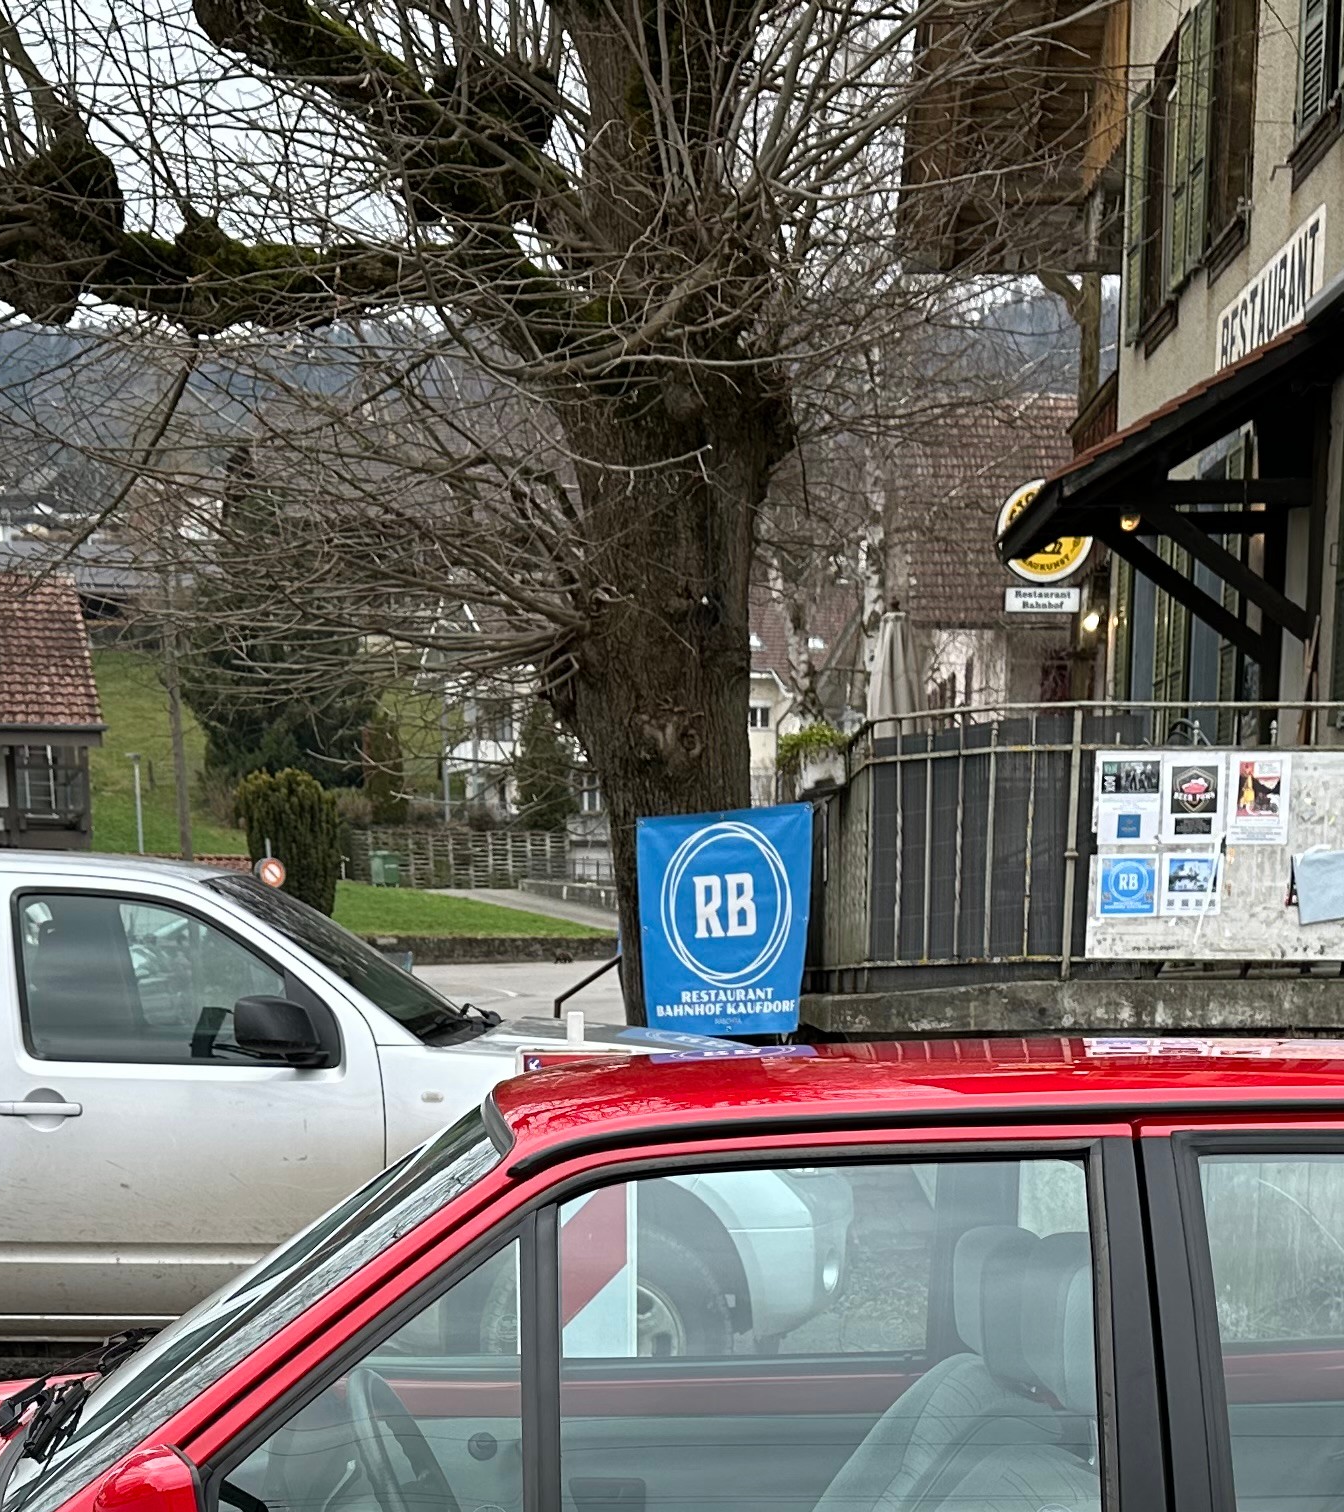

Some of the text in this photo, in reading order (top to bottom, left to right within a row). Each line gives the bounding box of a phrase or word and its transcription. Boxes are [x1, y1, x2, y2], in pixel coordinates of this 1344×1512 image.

[1220, 217, 1320, 371] RESTAURANT
[1015, 590, 1071, 600] Restaurant
[1118, 873, 1139, 891] RB
[692, 872, 757, 939] RB
[680, 987, 774, 1003] RESTAURANT
[656, 999, 796, 1017] BAHNHOF KAUFDORF
